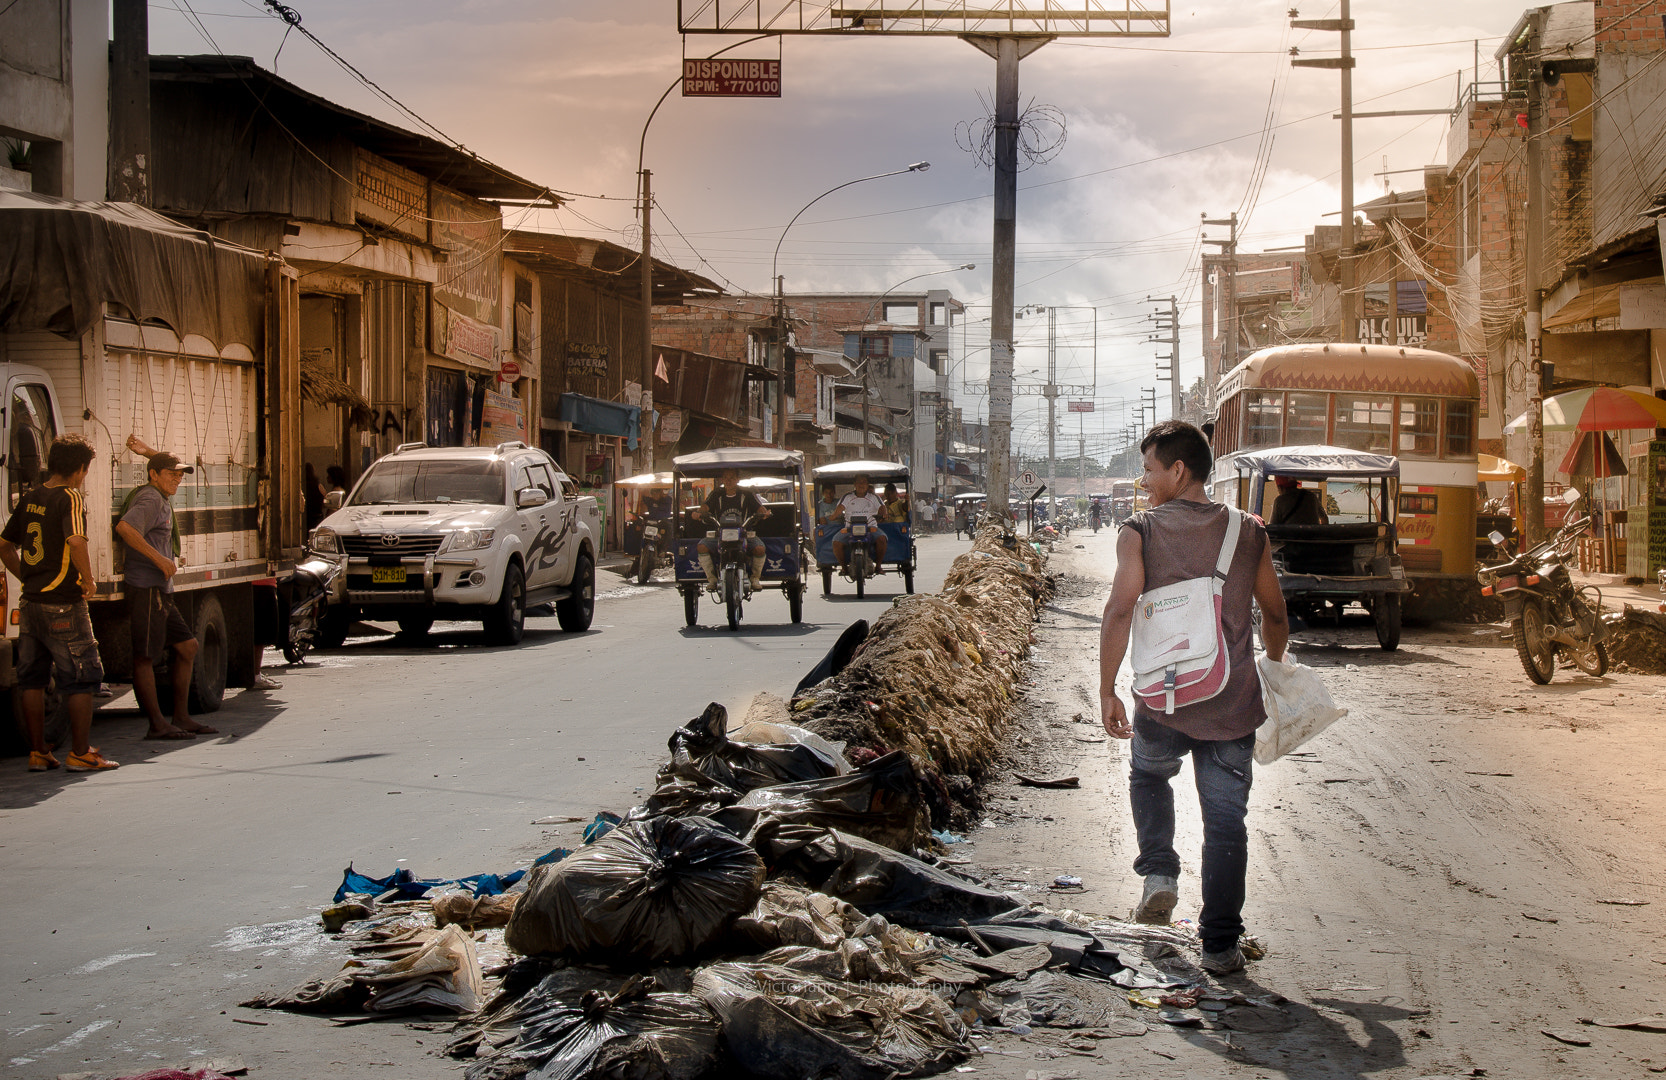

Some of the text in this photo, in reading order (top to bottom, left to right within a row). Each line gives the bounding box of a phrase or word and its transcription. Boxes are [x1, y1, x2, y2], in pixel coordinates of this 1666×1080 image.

[685, 62, 778, 79] DISPONIBLE
[686, 81, 719, 92] RPM:
[1358, 317, 1427, 339] ALQUIL
[23, 521, 45, 566] 3
